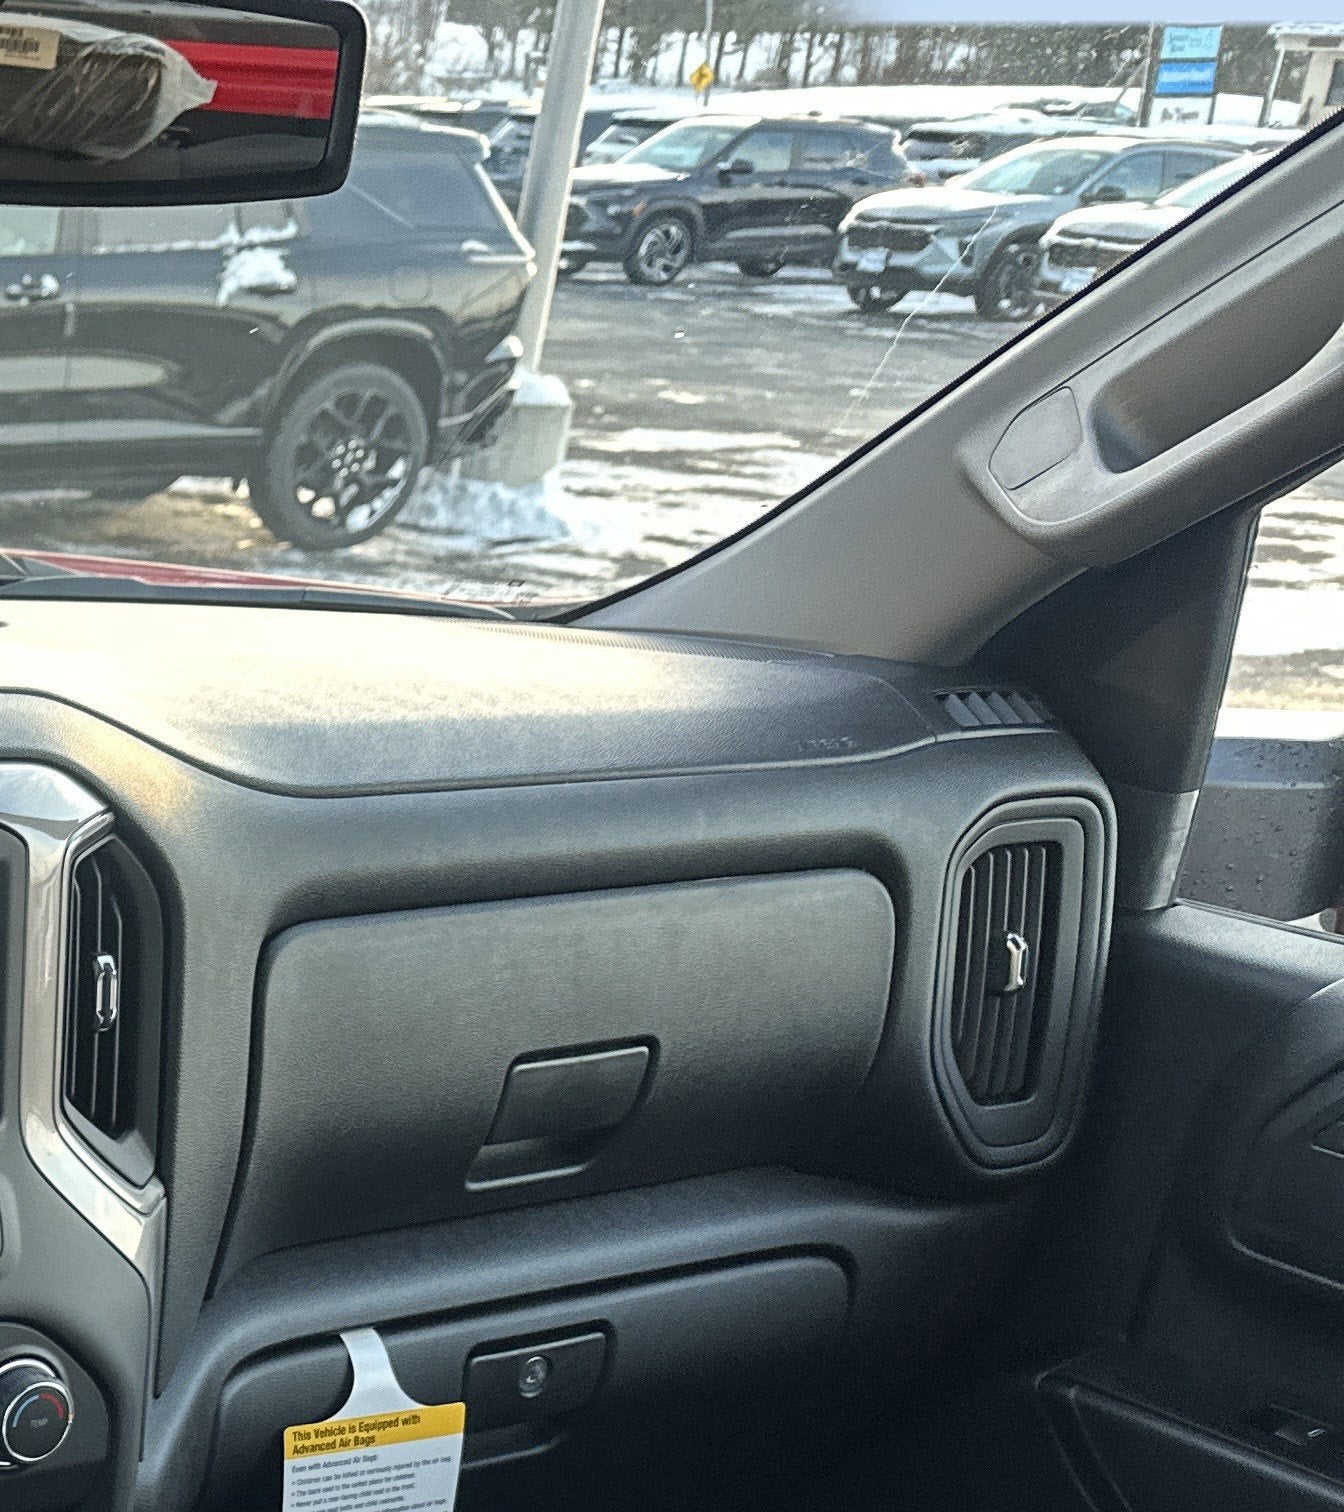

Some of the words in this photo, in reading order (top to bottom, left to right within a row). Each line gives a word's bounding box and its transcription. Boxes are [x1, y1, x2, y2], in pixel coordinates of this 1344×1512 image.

[292, 1430, 311, 1442] This
[314, 1426, 346, 1439] Vehicle
[348, 1423, 356, 1433] is
[359, 1417, 399, 1433] Equipped
[401, 1413, 421, 1426] with
[292, 1440, 336, 1455] Advanced
[339, 1437, 351, 1448] Air
[354, 1435, 376, 1447] Bags
